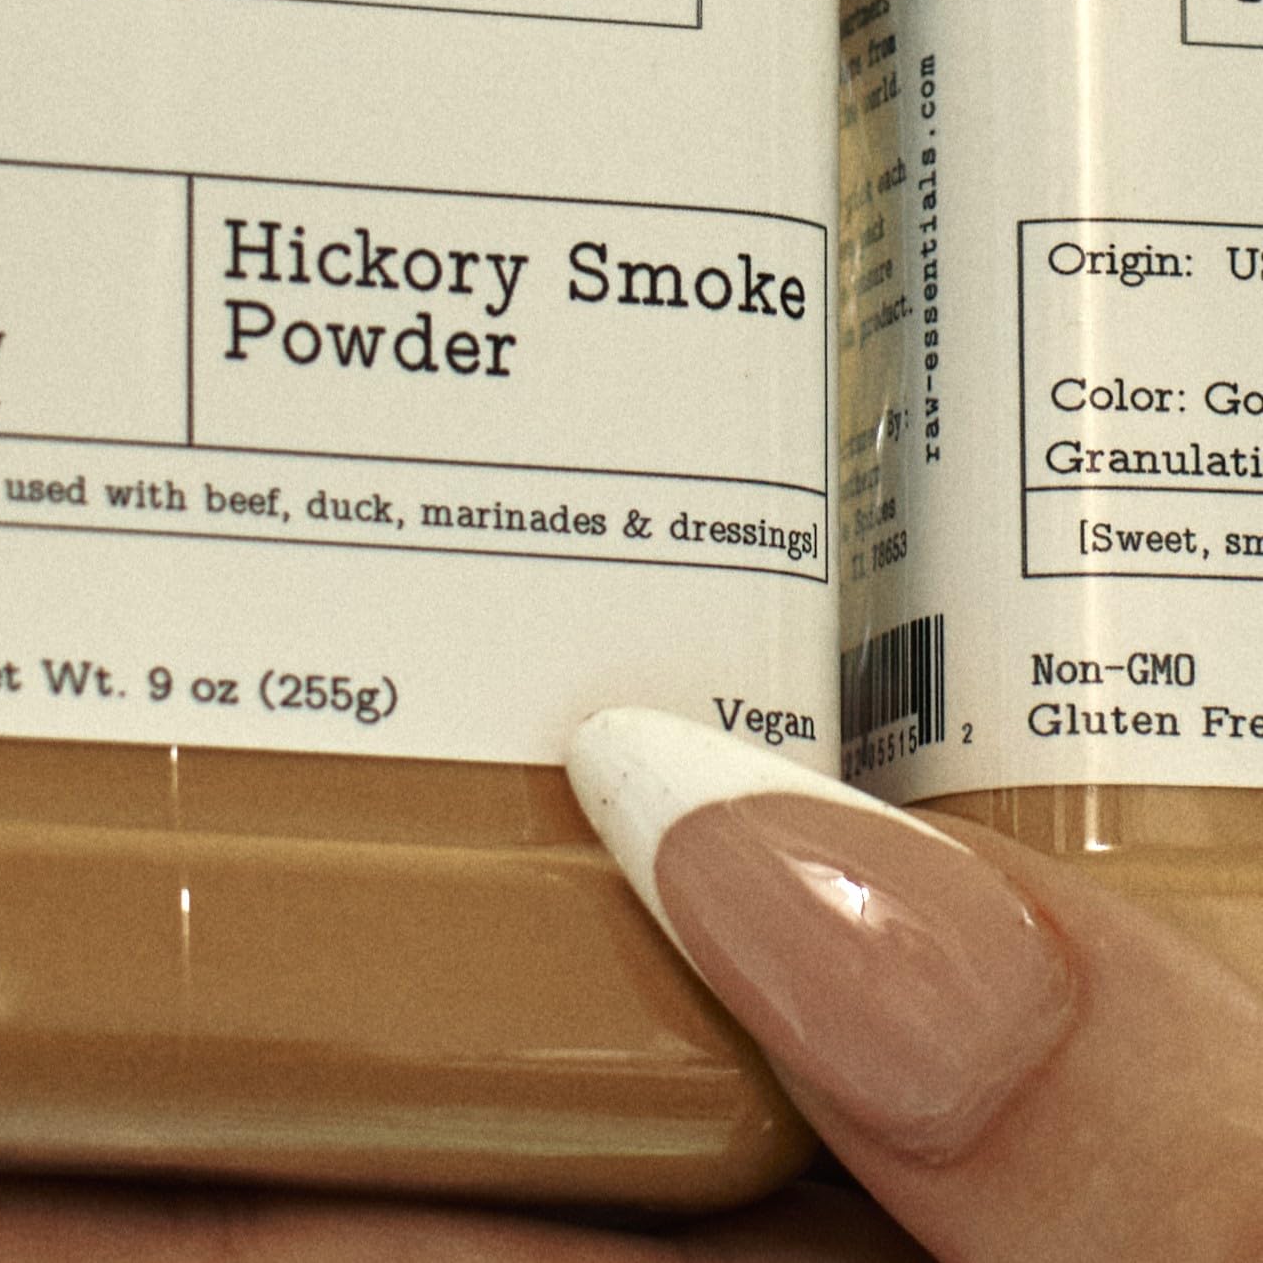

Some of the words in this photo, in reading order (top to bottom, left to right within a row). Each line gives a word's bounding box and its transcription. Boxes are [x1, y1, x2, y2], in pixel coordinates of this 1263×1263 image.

[224, 218, 529, 317] Hickory
[568, 241, 807, 320] Smoke
[917, 54, 941, 464] raw-essentials.com
[1048, 242, 1193, 287] Origin:
[224, 299, 517, 377] Powder
[1051, 378, 1186, 412] Color:
[1046, 441, 1263, 478] Granulati
[4, 476, 87, 506] used
[104, 482, 188, 512] with
[204, 483, 291, 523] beef,
[307, 489, 405, 530] duck,
[421, 501, 606, 536] marinades
[623, 509, 653, 540] &
[1079, 520, 1210, 560] [Sweet,
[43, 658, 127, 701] Wt.
[146, 665, 173, 703] 9
[191, 675, 240, 708] oz
[259, 669, 401, 725] (255g)
[1032, 653, 1195, 687] Non-GMO
[711, 697, 817, 746] Vegan
[1027, 703, 1179, 737] Gluten
